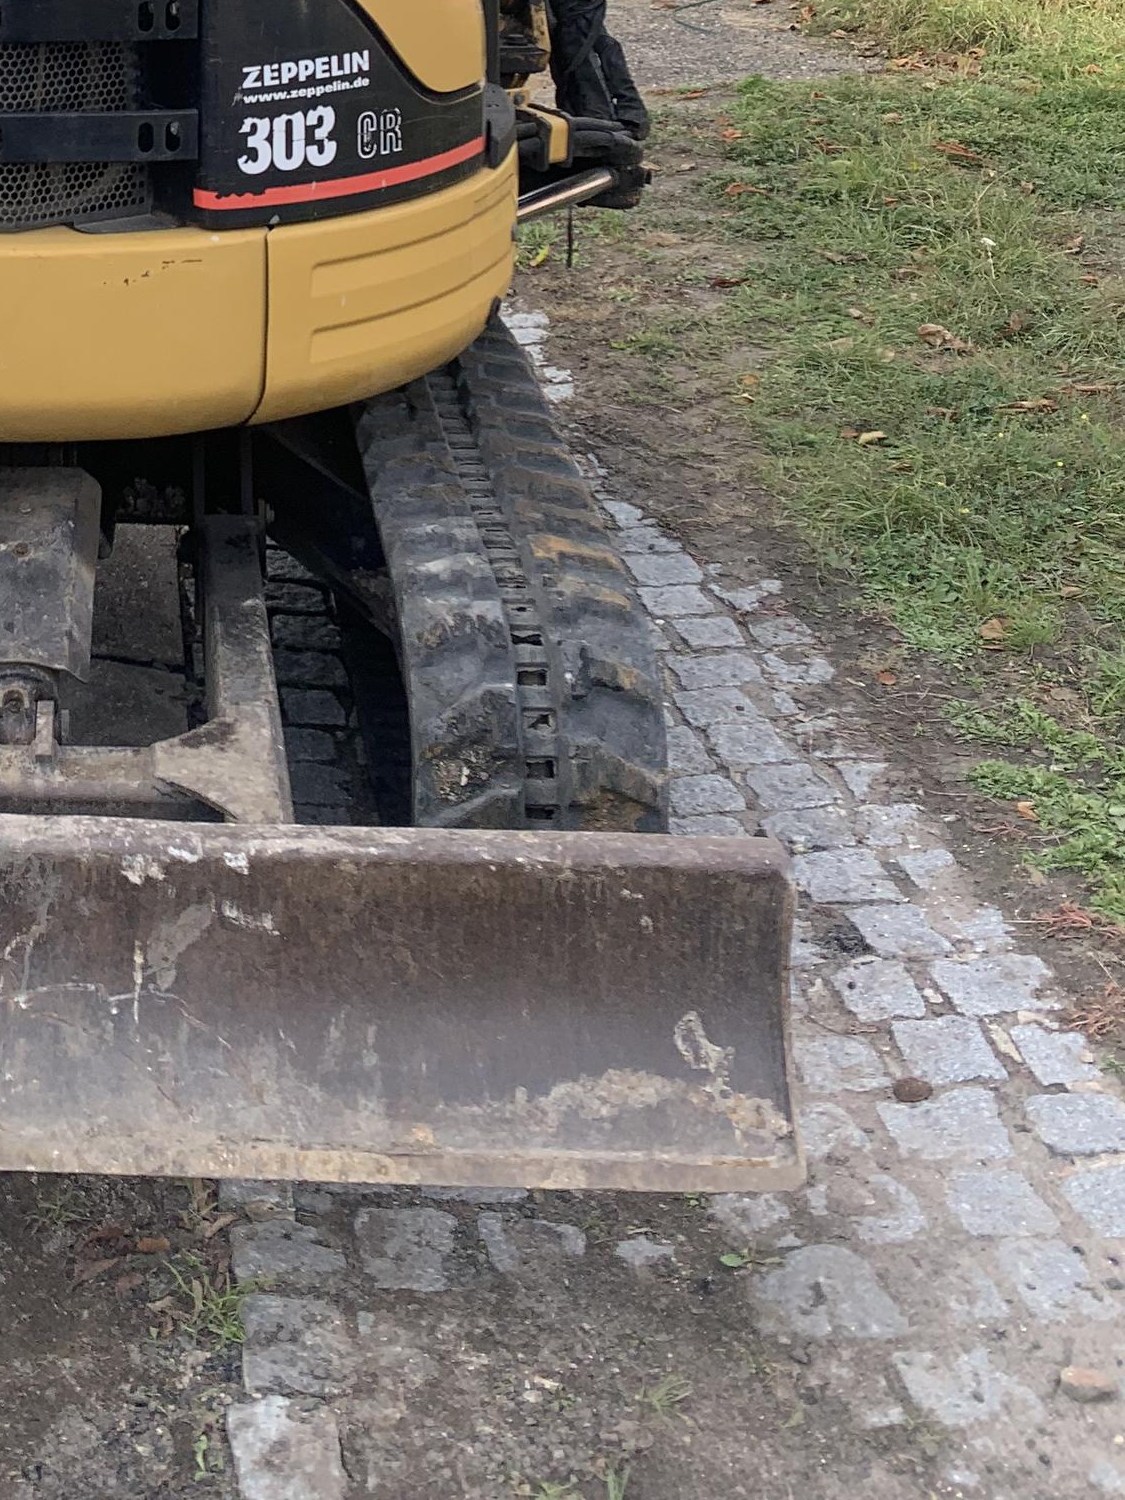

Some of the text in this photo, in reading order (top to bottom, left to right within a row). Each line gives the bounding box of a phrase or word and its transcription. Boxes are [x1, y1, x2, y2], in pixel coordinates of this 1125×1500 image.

[241, 49, 371, 90] ZEPPELIN
[241, 76, 371, 104] www.zeppelin.de
[236, 104, 403, 176] 303 CR
